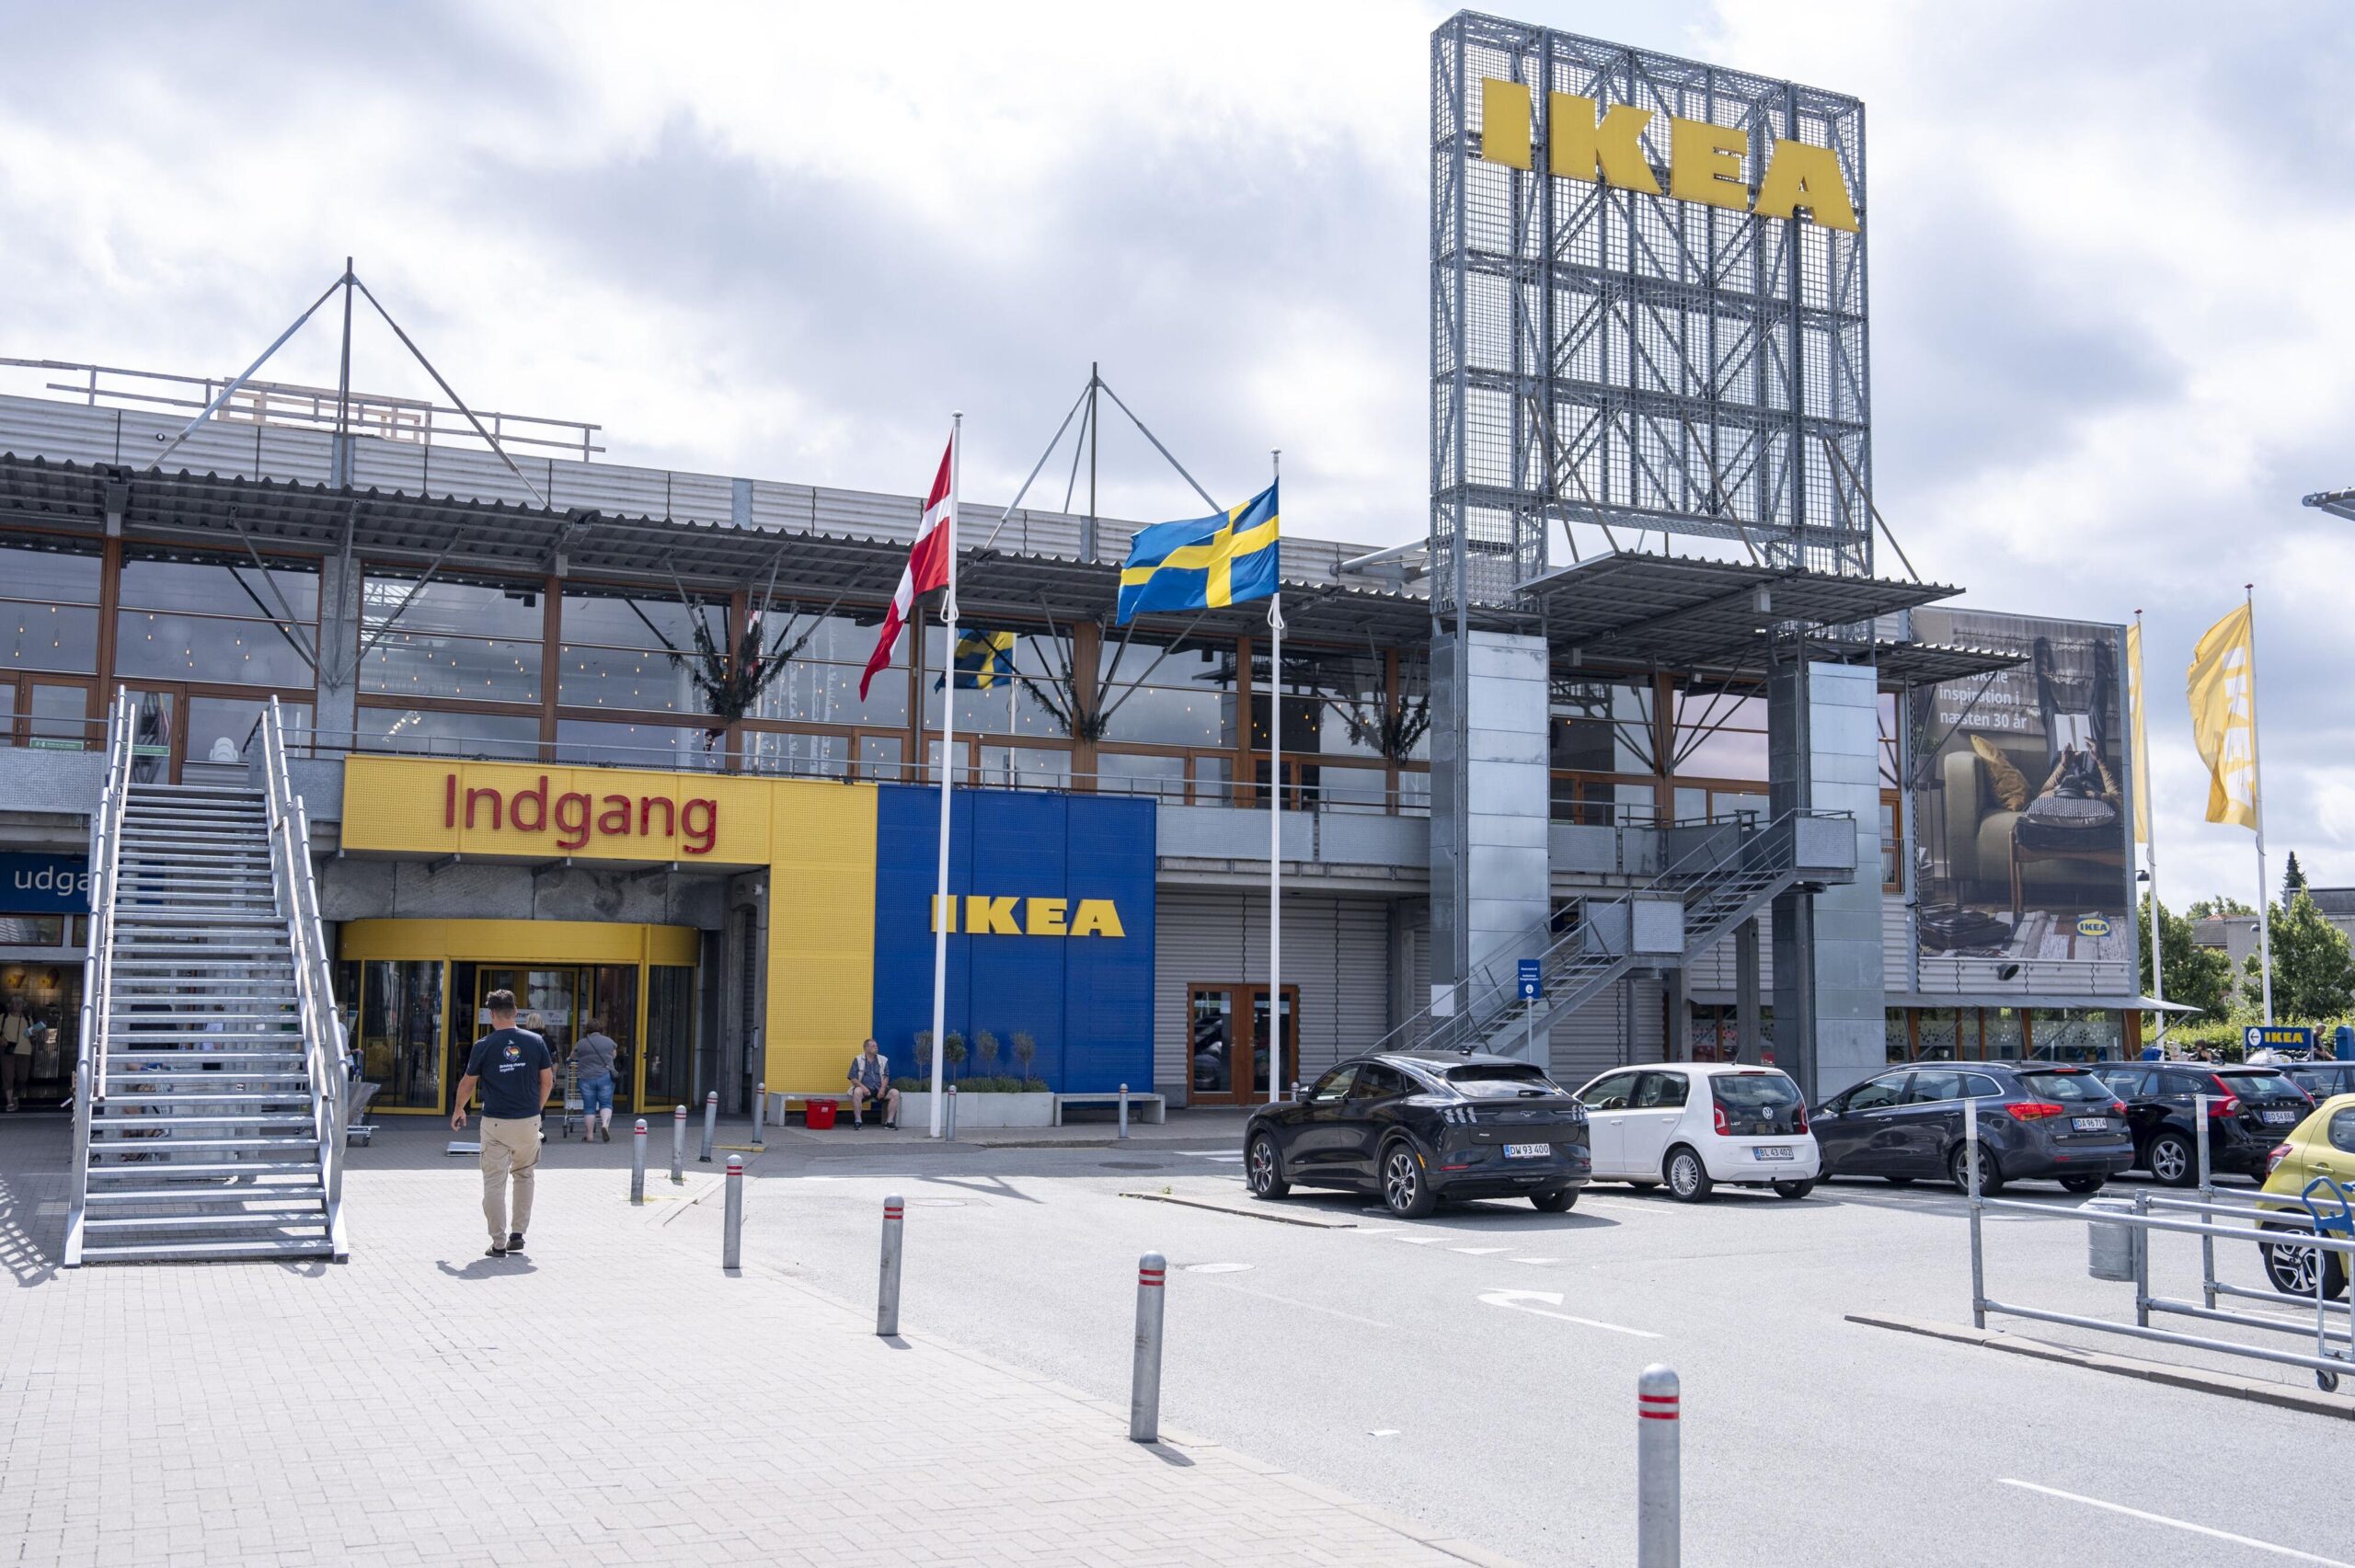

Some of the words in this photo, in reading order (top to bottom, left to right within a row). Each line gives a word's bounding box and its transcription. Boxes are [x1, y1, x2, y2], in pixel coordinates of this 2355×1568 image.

[1481, 76, 1860, 233] IKEA
[1939, 685, 2012, 704] inspiration
[2016, 691, 2020, 705] i
[1940, 712, 1990, 727] næsten
[1993, 713, 2009, 728] 30
[2013, 713, 2028, 729] år
[445, 773, 718, 854] Indgang
[15, 865, 89, 897] udga
[931, 894, 1127, 937] IKEA
[2264, 1032, 2304, 1043] IKEA
[2078, 1119, 2086, 1127] DA
[2088, 1119, 2096, 1127] 96
[2096, 1119, 2107, 1127] 714
[1510, 1146, 1522, 1155] DW
[1523, 1145, 1533, 1154] 93
[1534, 1145, 1549, 1153] 400
[1760, 1149, 1770, 1157] BL
[1771, 1149, 1779, 1157] 43
[1780, 1148, 1792, 1156] 402
